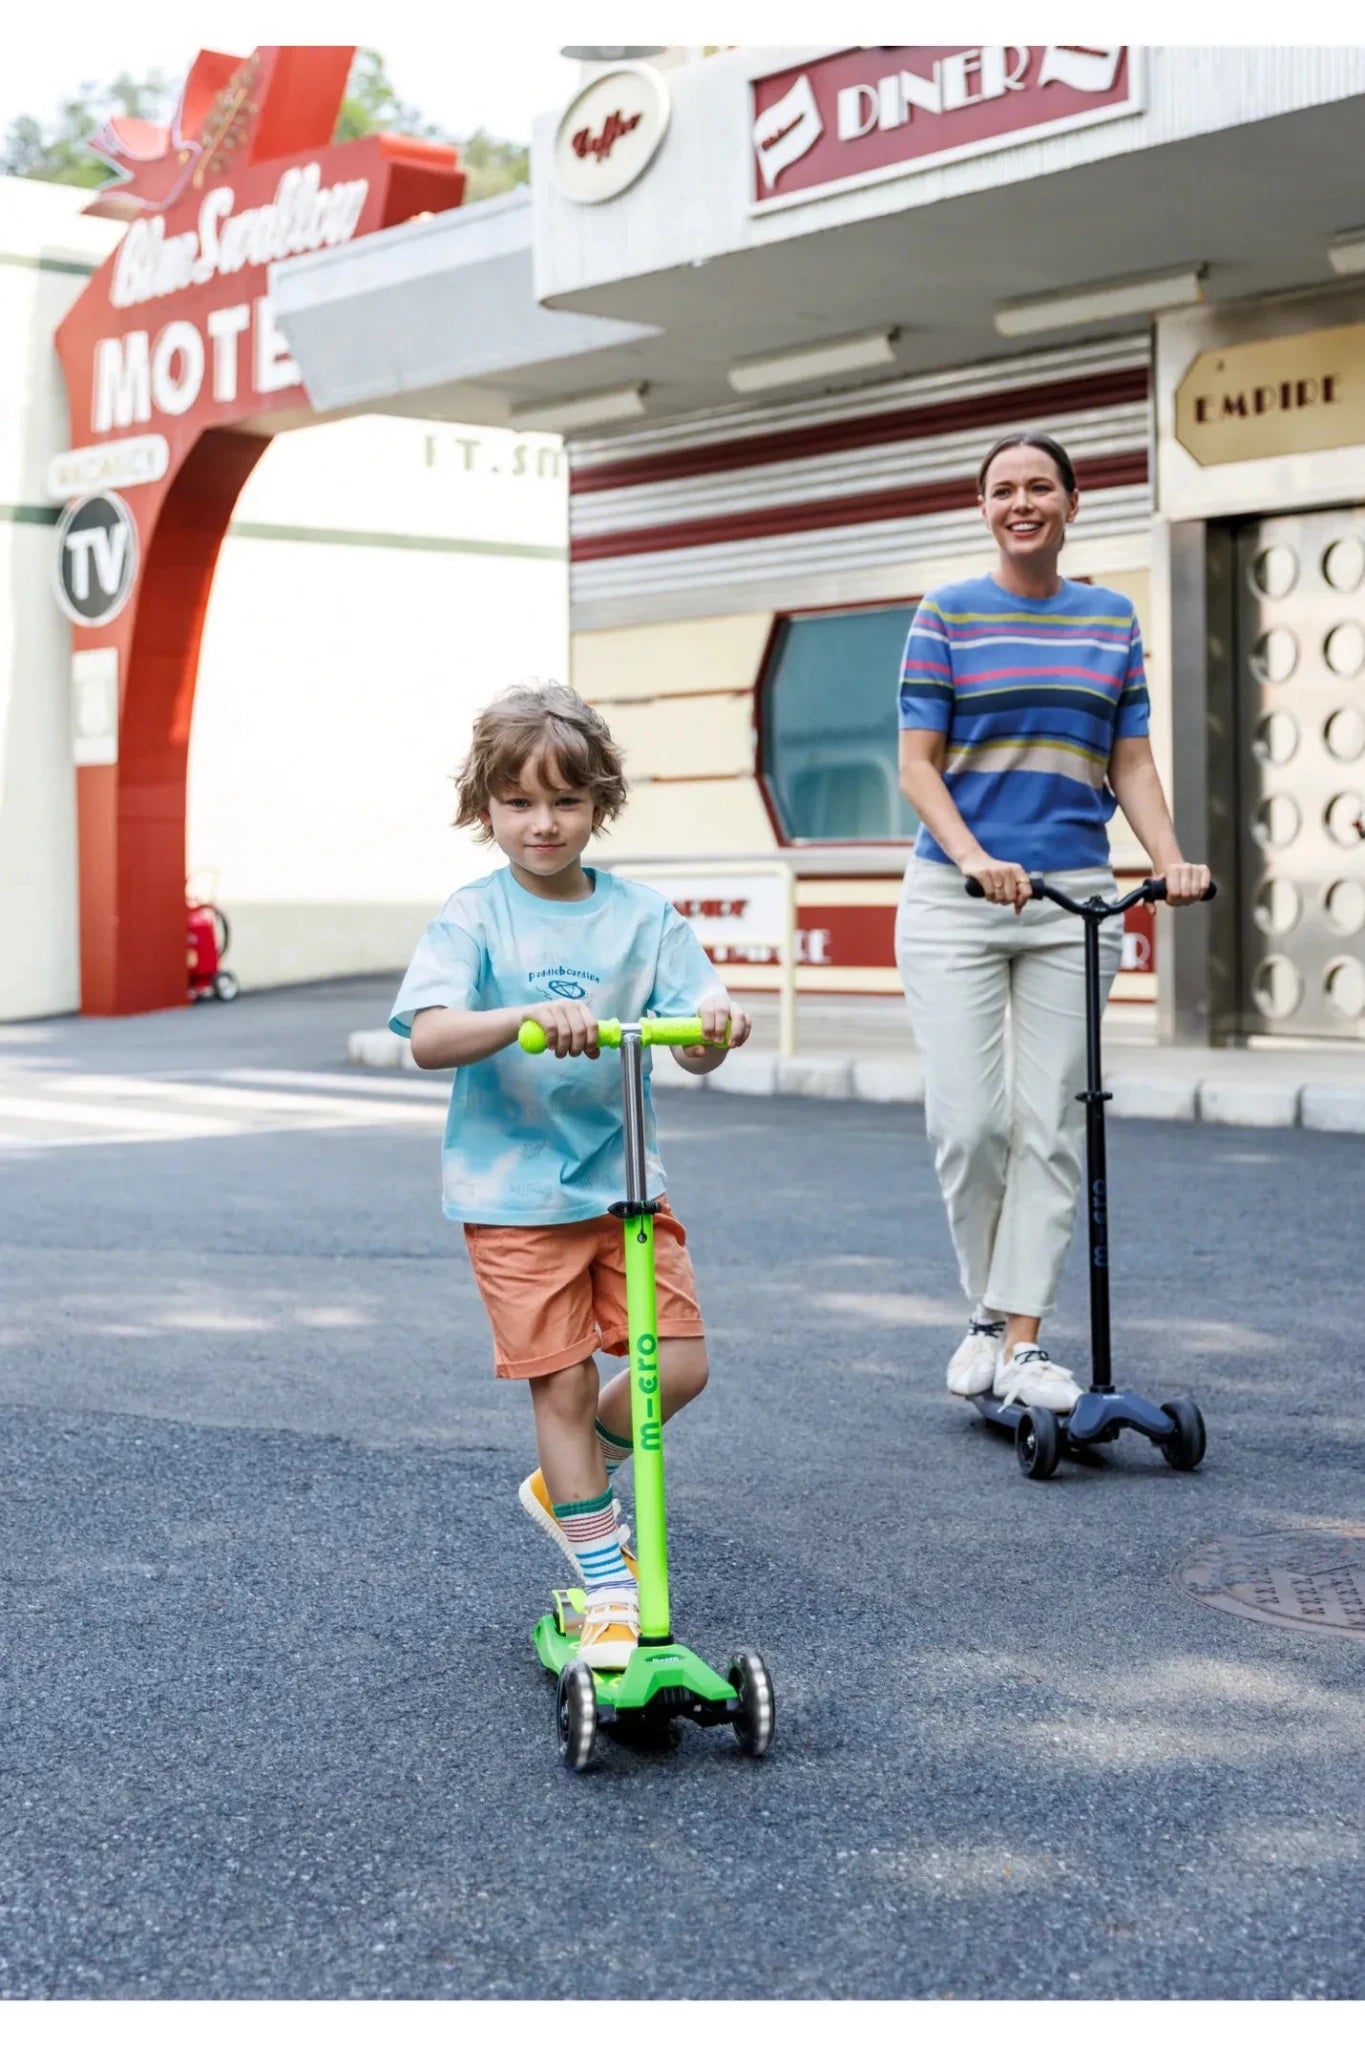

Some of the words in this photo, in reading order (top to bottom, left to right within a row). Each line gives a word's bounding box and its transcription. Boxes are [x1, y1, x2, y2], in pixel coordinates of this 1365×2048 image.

[838, 46, 1030, 141] DINER
[1195, 373, 1341, 425] EMPIRE
[66, 522, 128, 600] TV
[528, 966, 600, 983] paddleboarding
